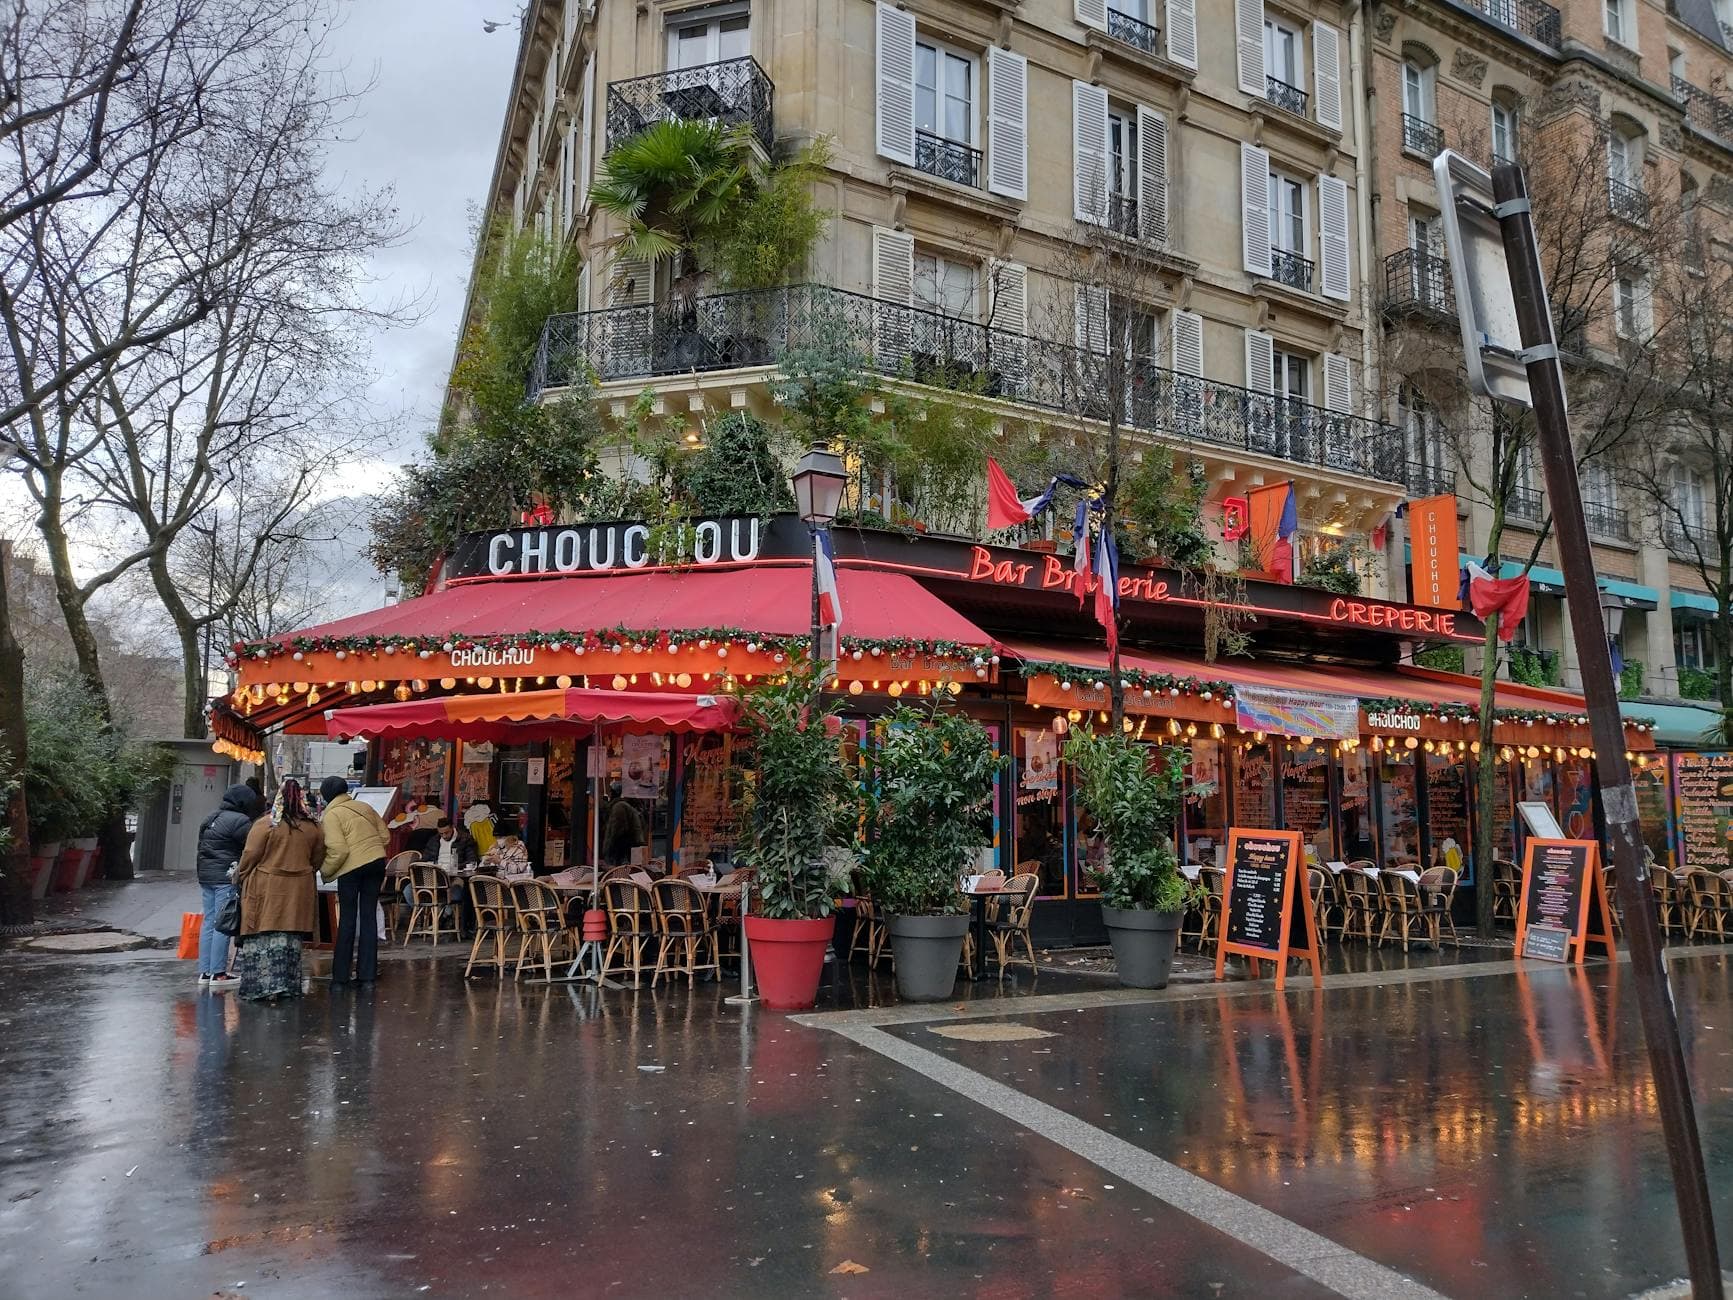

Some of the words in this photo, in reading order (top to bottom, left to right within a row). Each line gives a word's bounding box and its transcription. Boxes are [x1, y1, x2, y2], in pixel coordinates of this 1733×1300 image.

[1428, 512, 1440, 605] CHOUCHOU
[970, 546, 1034, 585] Bar
[1042, 554, 1171, 602] Brerie
[1330, 597, 1456, 636] CREPERIE
[451, 647, 535, 667] CHOUCHOU
[1288, 697, 1308, 708] Happy
[1368, 712, 1420, 731] CHOUCHOU
